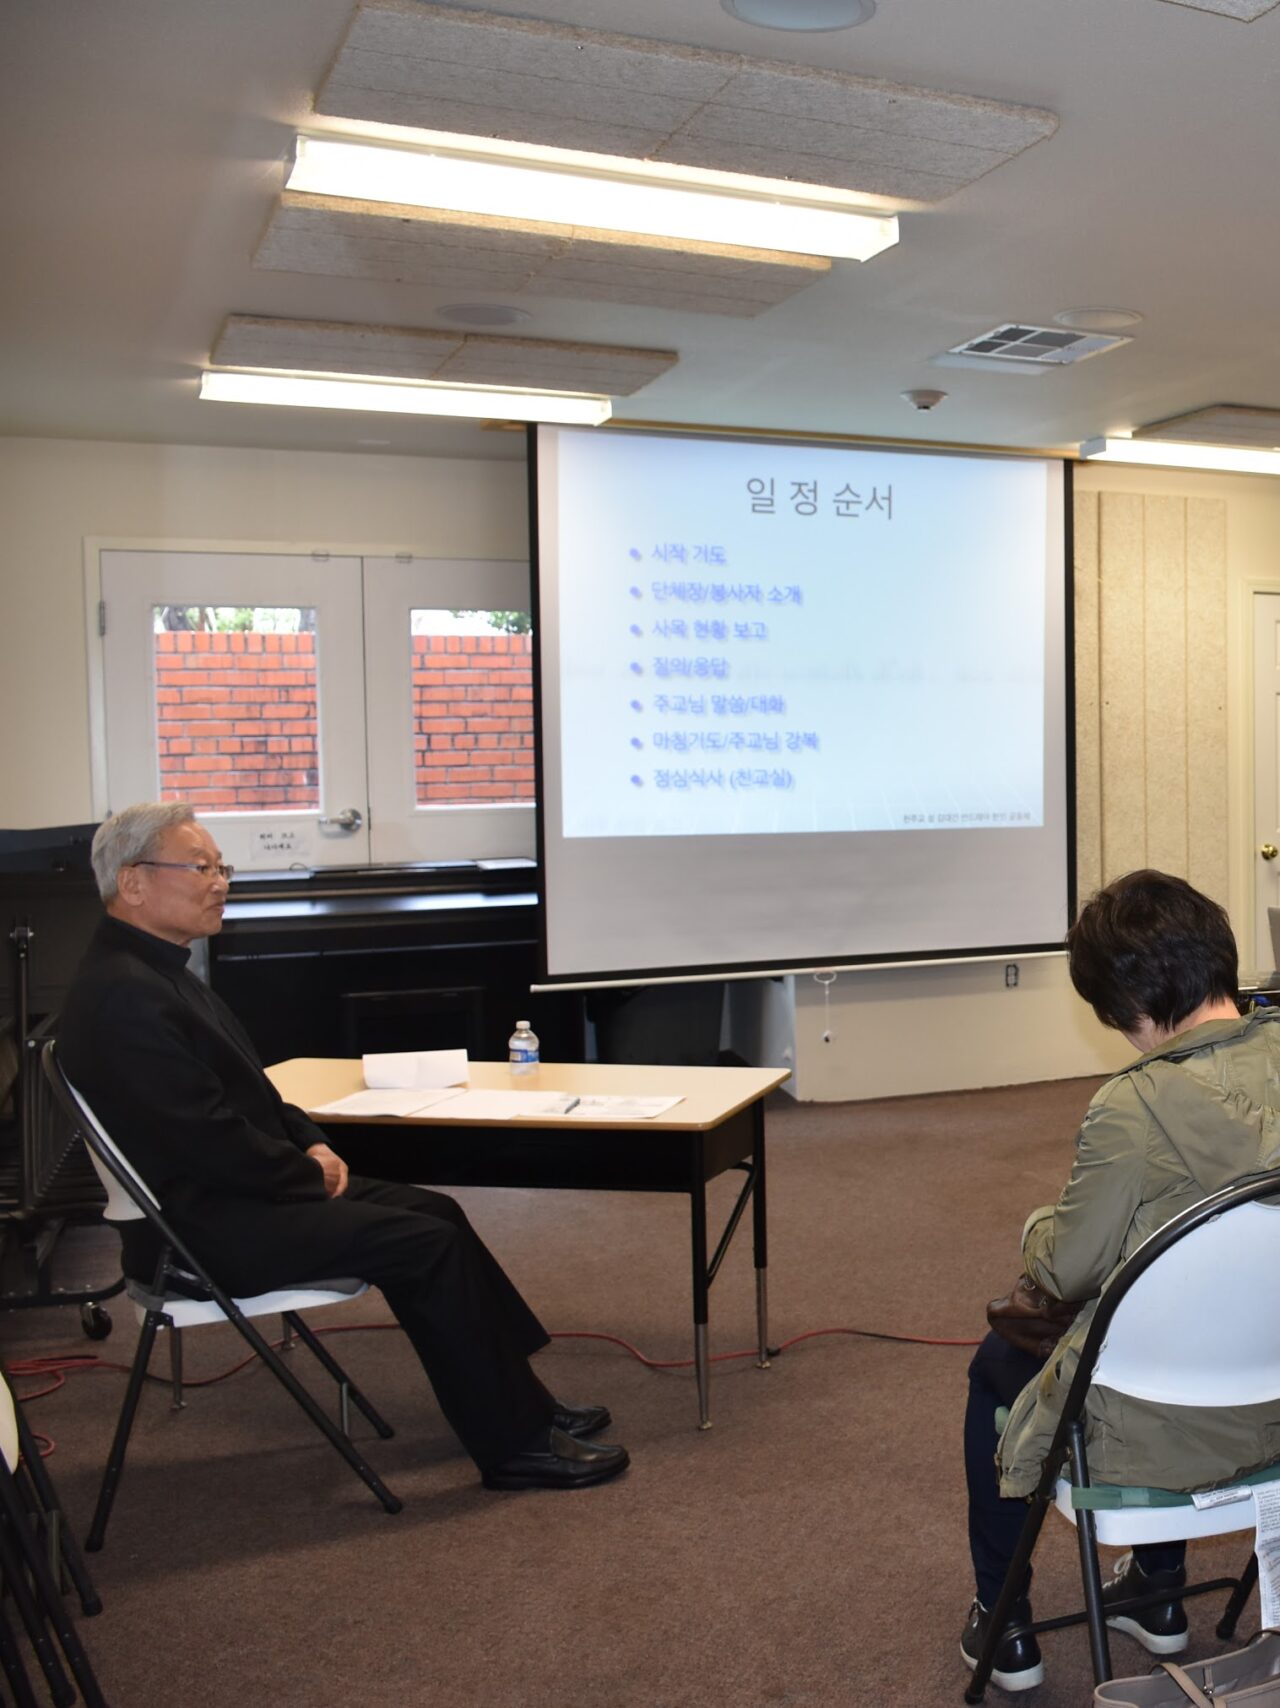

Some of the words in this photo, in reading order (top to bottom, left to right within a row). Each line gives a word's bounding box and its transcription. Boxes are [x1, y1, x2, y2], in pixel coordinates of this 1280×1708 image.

[652, 543, 687, 563] 시작
[693, 544, 727, 565] 기도
[768, 585, 803, 605] 소개
[652, 619, 687, 640] 사목
[694, 619, 728, 640] 현황
[733, 621, 768, 640] 보고
[653, 657, 730, 679] 질의/응답
[653, 694, 706, 715] 주교님
[711, 694, 787, 715] 말씀/대화
[653, 731, 780, 752] 마침기도/주교님
[785, 731, 820, 752] 강복
[654, 768, 724, 789] 점심식사
[729, 768, 795, 790] (친교실)
